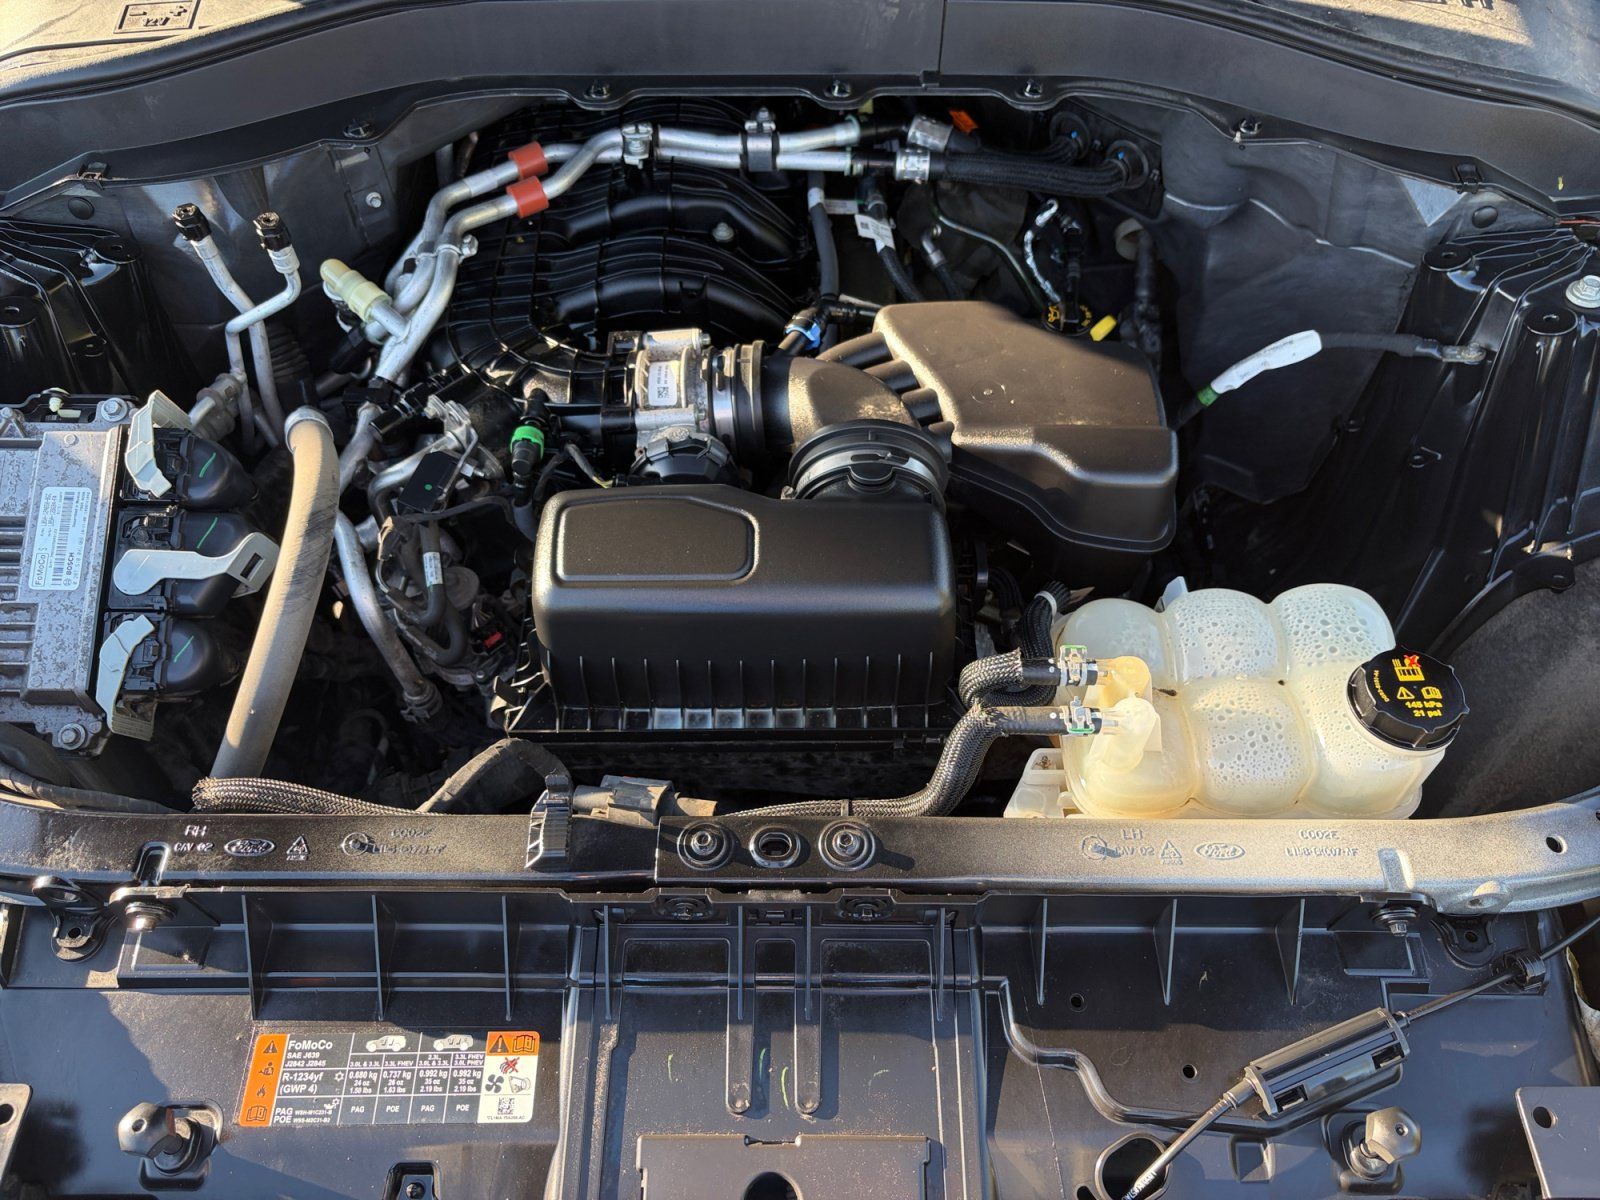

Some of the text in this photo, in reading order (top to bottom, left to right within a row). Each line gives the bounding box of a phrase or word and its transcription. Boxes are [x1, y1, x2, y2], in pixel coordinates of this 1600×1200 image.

[66, 552, 75, 576] BOSCH
[34, 554, 46, 586] FoMoCo
[1405, 701, 1424, 709] 145
[1413, 709, 1443, 718] 21 psi
[1121, 828, 1144, 840] LH
[231, 840, 267, 854] Ford
[1203, 843, 1239, 858] Ford
[288, 1039, 333, 1050] FoMoCo
[282, 1072, 324, 1083] R-1234yf
[369, 1071, 378, 1081] kg
[383, 1070, 411, 1080] 0.737 kg
[419, 1069, 448, 1079] 0.992 kg
[453, 1069, 482, 1079] 0.992 kg
[280, 1083, 318, 1095] (GWP 4)
[275, 1107, 293, 1116] PAG
[386, 1105, 400, 1113] POE
[421, 1104, 435, 1112] PAG
[456, 1104, 470, 1112] POE
[273, 1115, 292, 1124] POE
